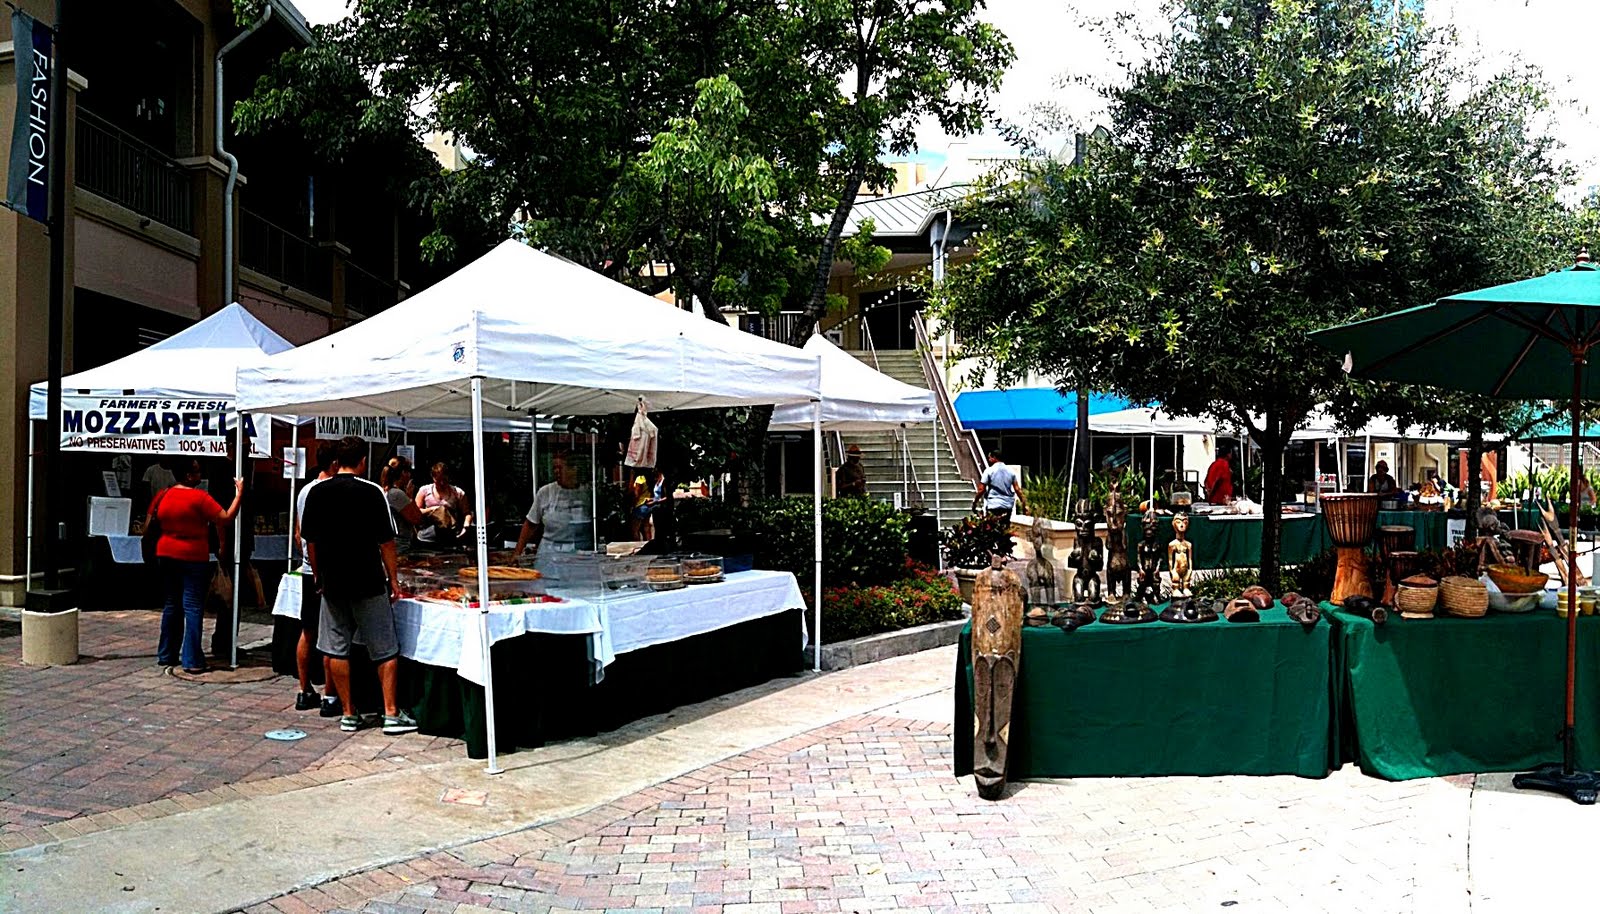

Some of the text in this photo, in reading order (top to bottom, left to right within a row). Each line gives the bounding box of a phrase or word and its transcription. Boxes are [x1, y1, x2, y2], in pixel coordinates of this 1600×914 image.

[28, 48, 48, 186] FASHION
[99, 399, 228, 411] FARMER'S FRESH
[63, 409, 258, 438] MOZZARELLA
[69, 436, 84, 448] NO
[87, 437, 166, 451] PRESERVATIVES
[178, 440, 206, 453] 100%
